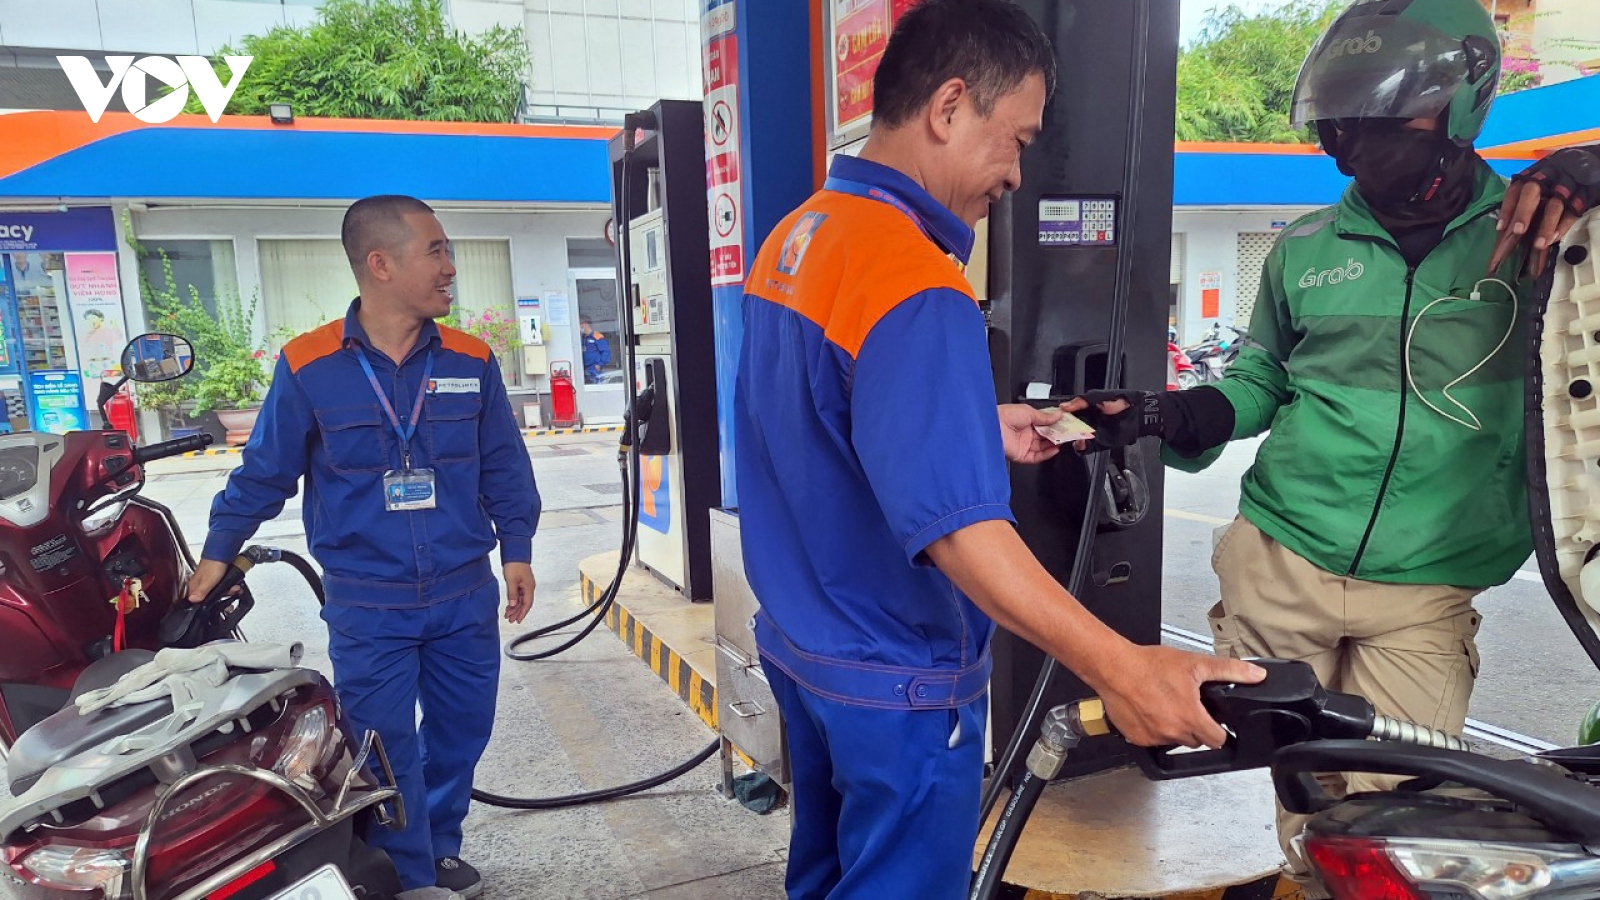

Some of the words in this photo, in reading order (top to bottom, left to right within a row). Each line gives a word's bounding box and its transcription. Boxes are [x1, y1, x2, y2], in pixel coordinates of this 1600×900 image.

[1329, 30, 1382, 60] Grab
[1299, 258, 1364, 288] Grab
[160, 781, 233, 821] HONDA
